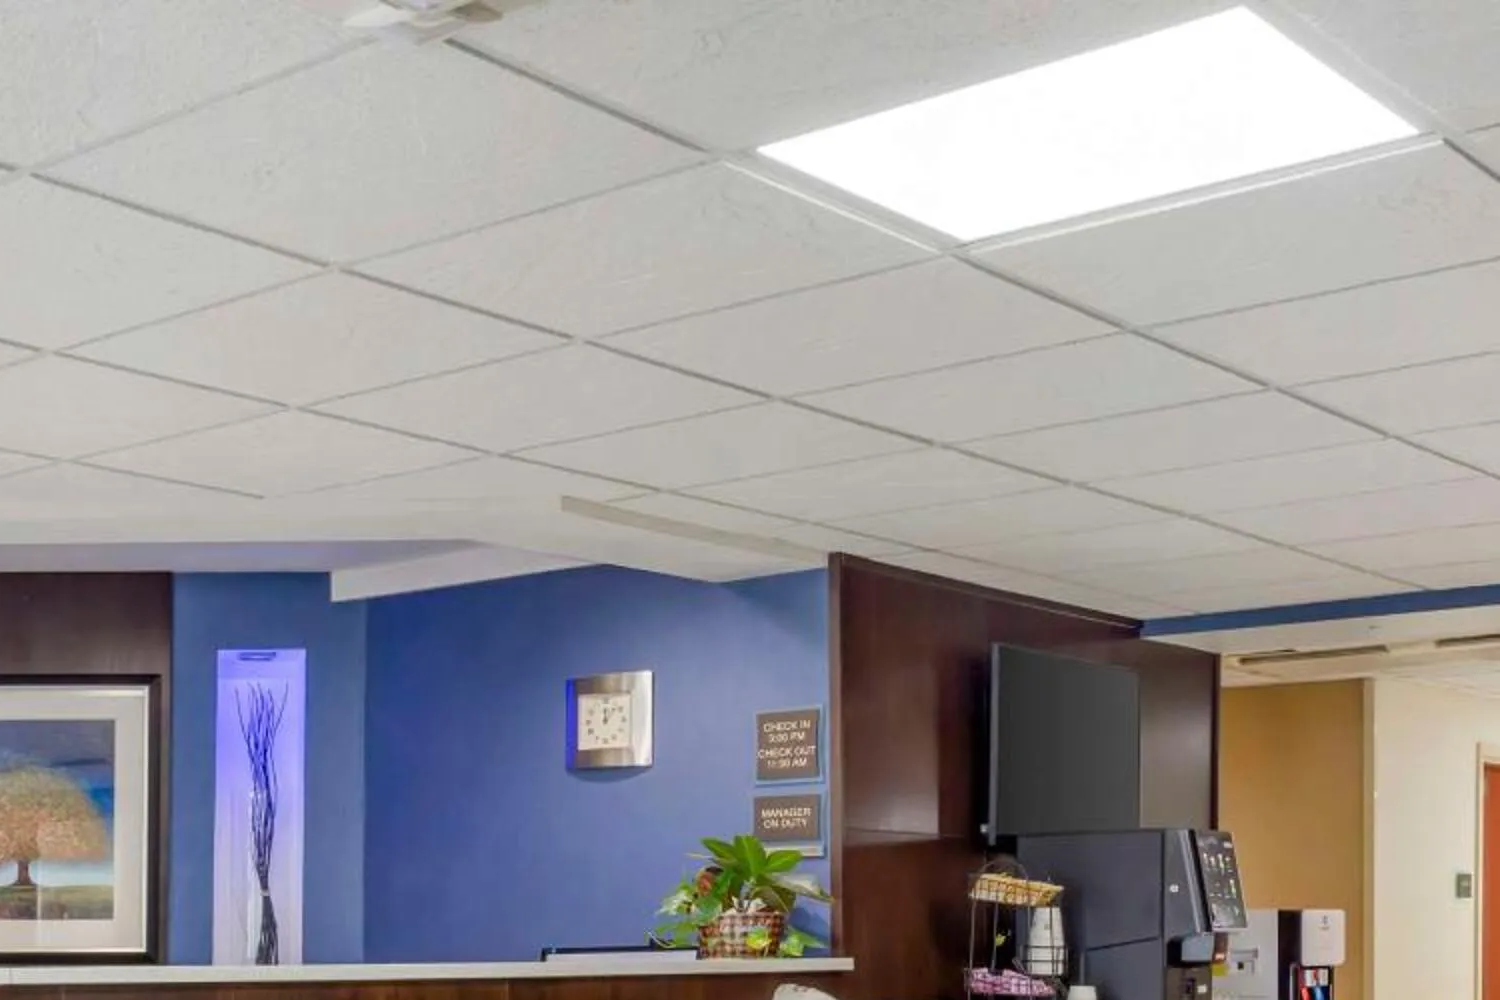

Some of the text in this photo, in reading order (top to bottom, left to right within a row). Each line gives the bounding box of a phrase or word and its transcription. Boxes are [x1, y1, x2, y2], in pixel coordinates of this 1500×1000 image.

[799, 719, 811, 730] IN
[757, 745, 816, 759] CHECK OUT
[792, 757, 808, 768] AM
[761, 807, 812, 818] MANAGER
[763, 817, 808, 829] ON DUTY
